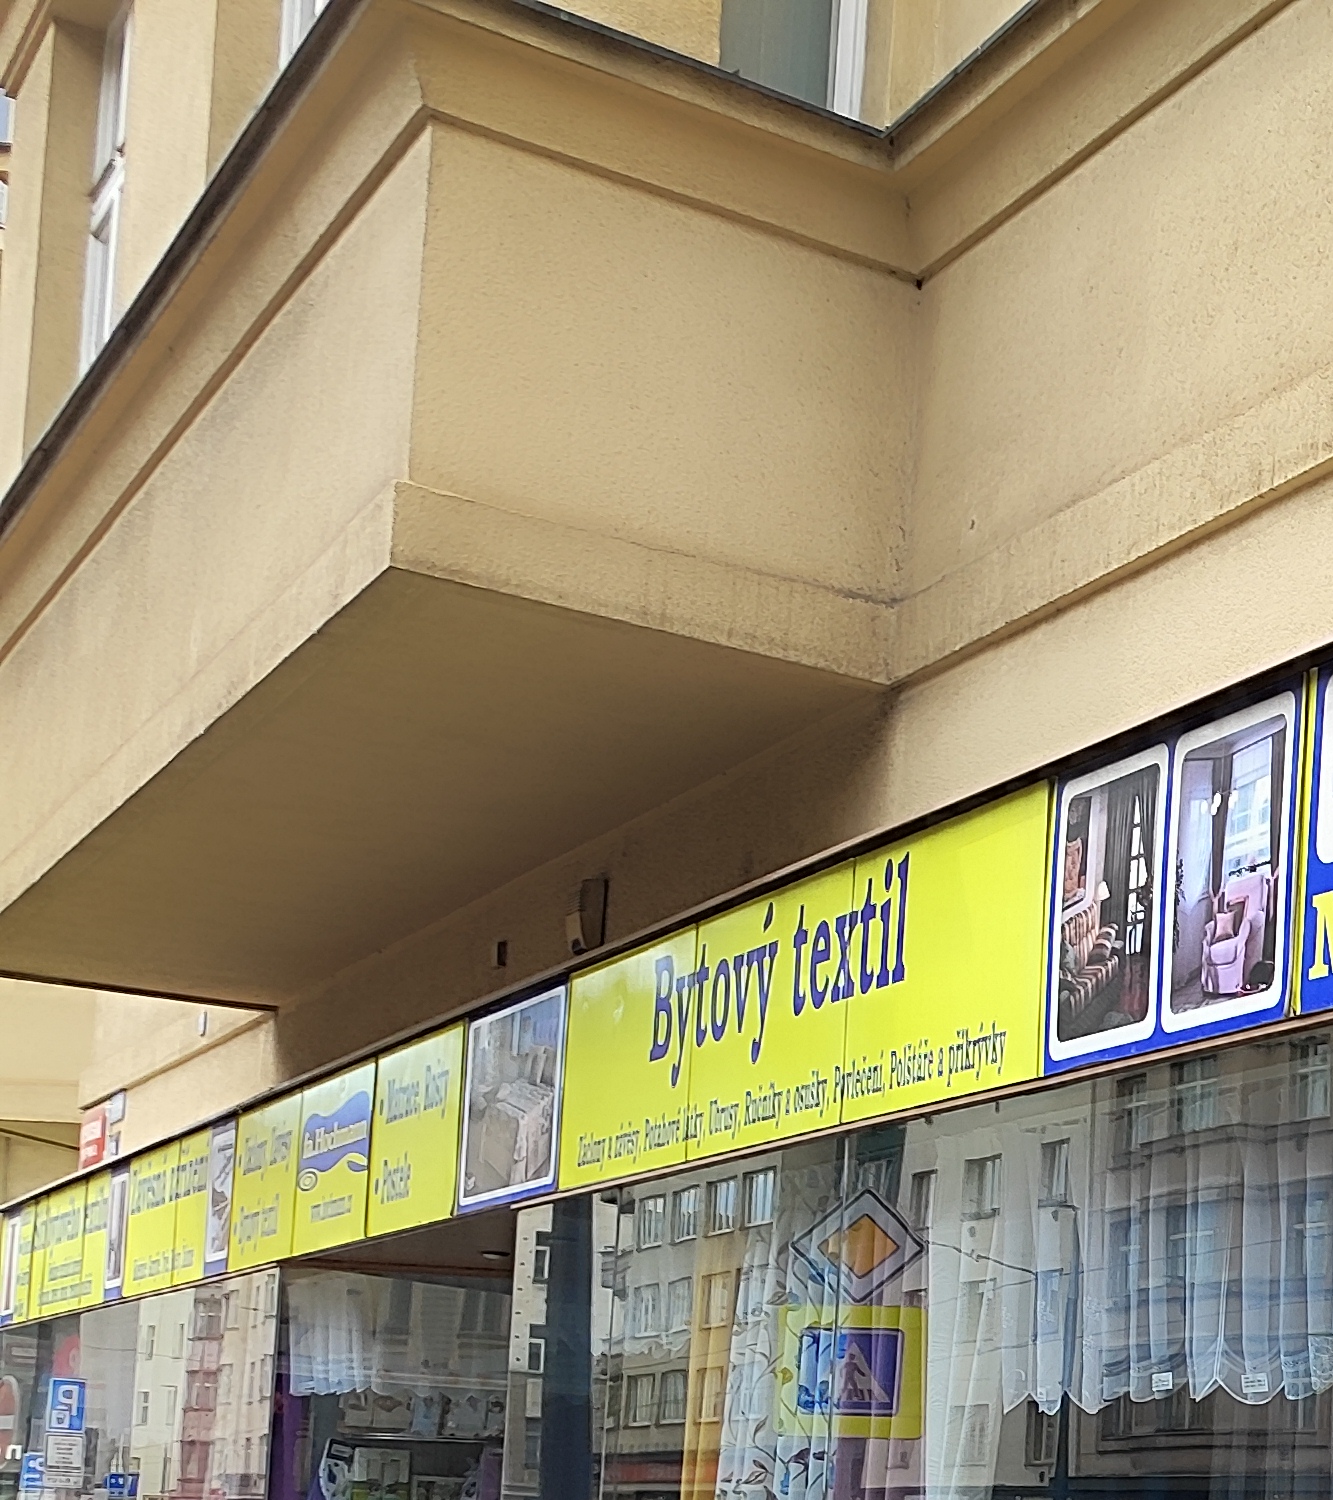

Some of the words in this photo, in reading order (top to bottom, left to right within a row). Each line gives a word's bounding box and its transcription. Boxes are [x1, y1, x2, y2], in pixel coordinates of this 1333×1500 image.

[649, 901, 779, 1089] Bytový
[793, 851, 911, 1017] textil
[889, 1038, 935, 1090] Polštáře
[937, 1047, 944, 1078] a
[946, 1020, 1007, 1088] přikrývky
